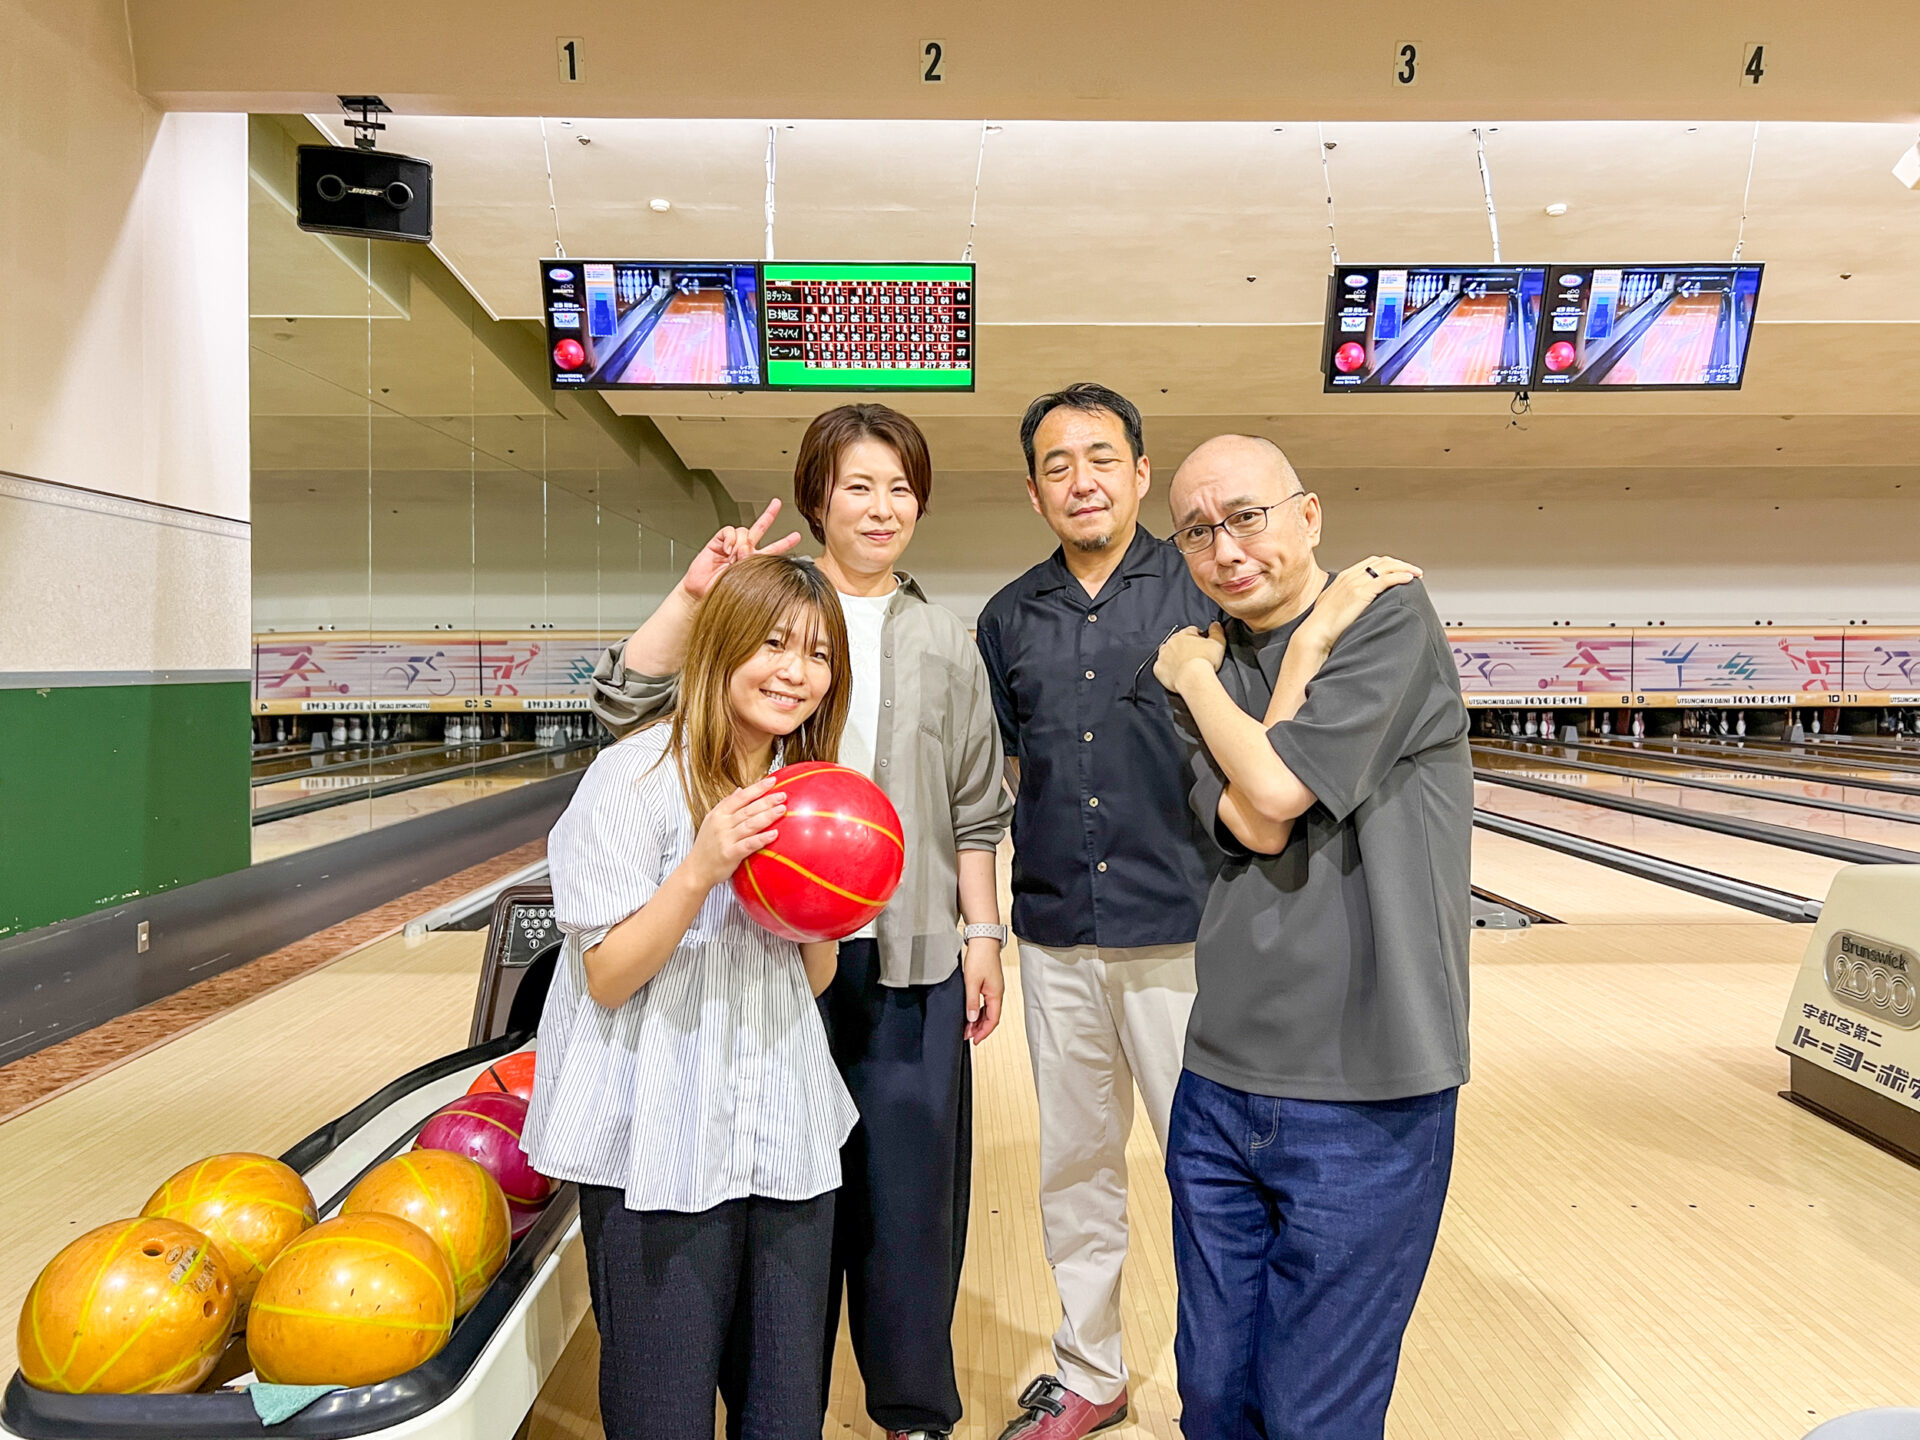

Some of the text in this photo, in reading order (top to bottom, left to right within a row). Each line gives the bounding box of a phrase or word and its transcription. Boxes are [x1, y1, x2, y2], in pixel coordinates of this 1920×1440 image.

[563, 41, 577, 81] 1
[924, 42, 942, 82] 2
[1398, 44, 1417, 84] 3
[1745, 46, 1764, 84] 4
[348, 187, 383, 196] BOSE
[768, 309, 799, 320] B地区
[769, 347, 800, 357] ビール
[1524, 696, 1552, 705] TOYO
[1553, 696, 1583, 705] BOWL
[1621, 696, 1629, 704] 8
[1637, 696, 1645, 704] 9
[1732, 696, 1760, 705] TOYO
[1761, 695, 1792, 704] BOWL
[1828, 694, 1841, 703] 10
[1847, 694, 1858, 703] 11
[1841, 935, 1908, 972] Brunswick
[1833, 954, 1914, 1018] 2000
[1802, 1003, 1883, 1048] 宇都宮第二
